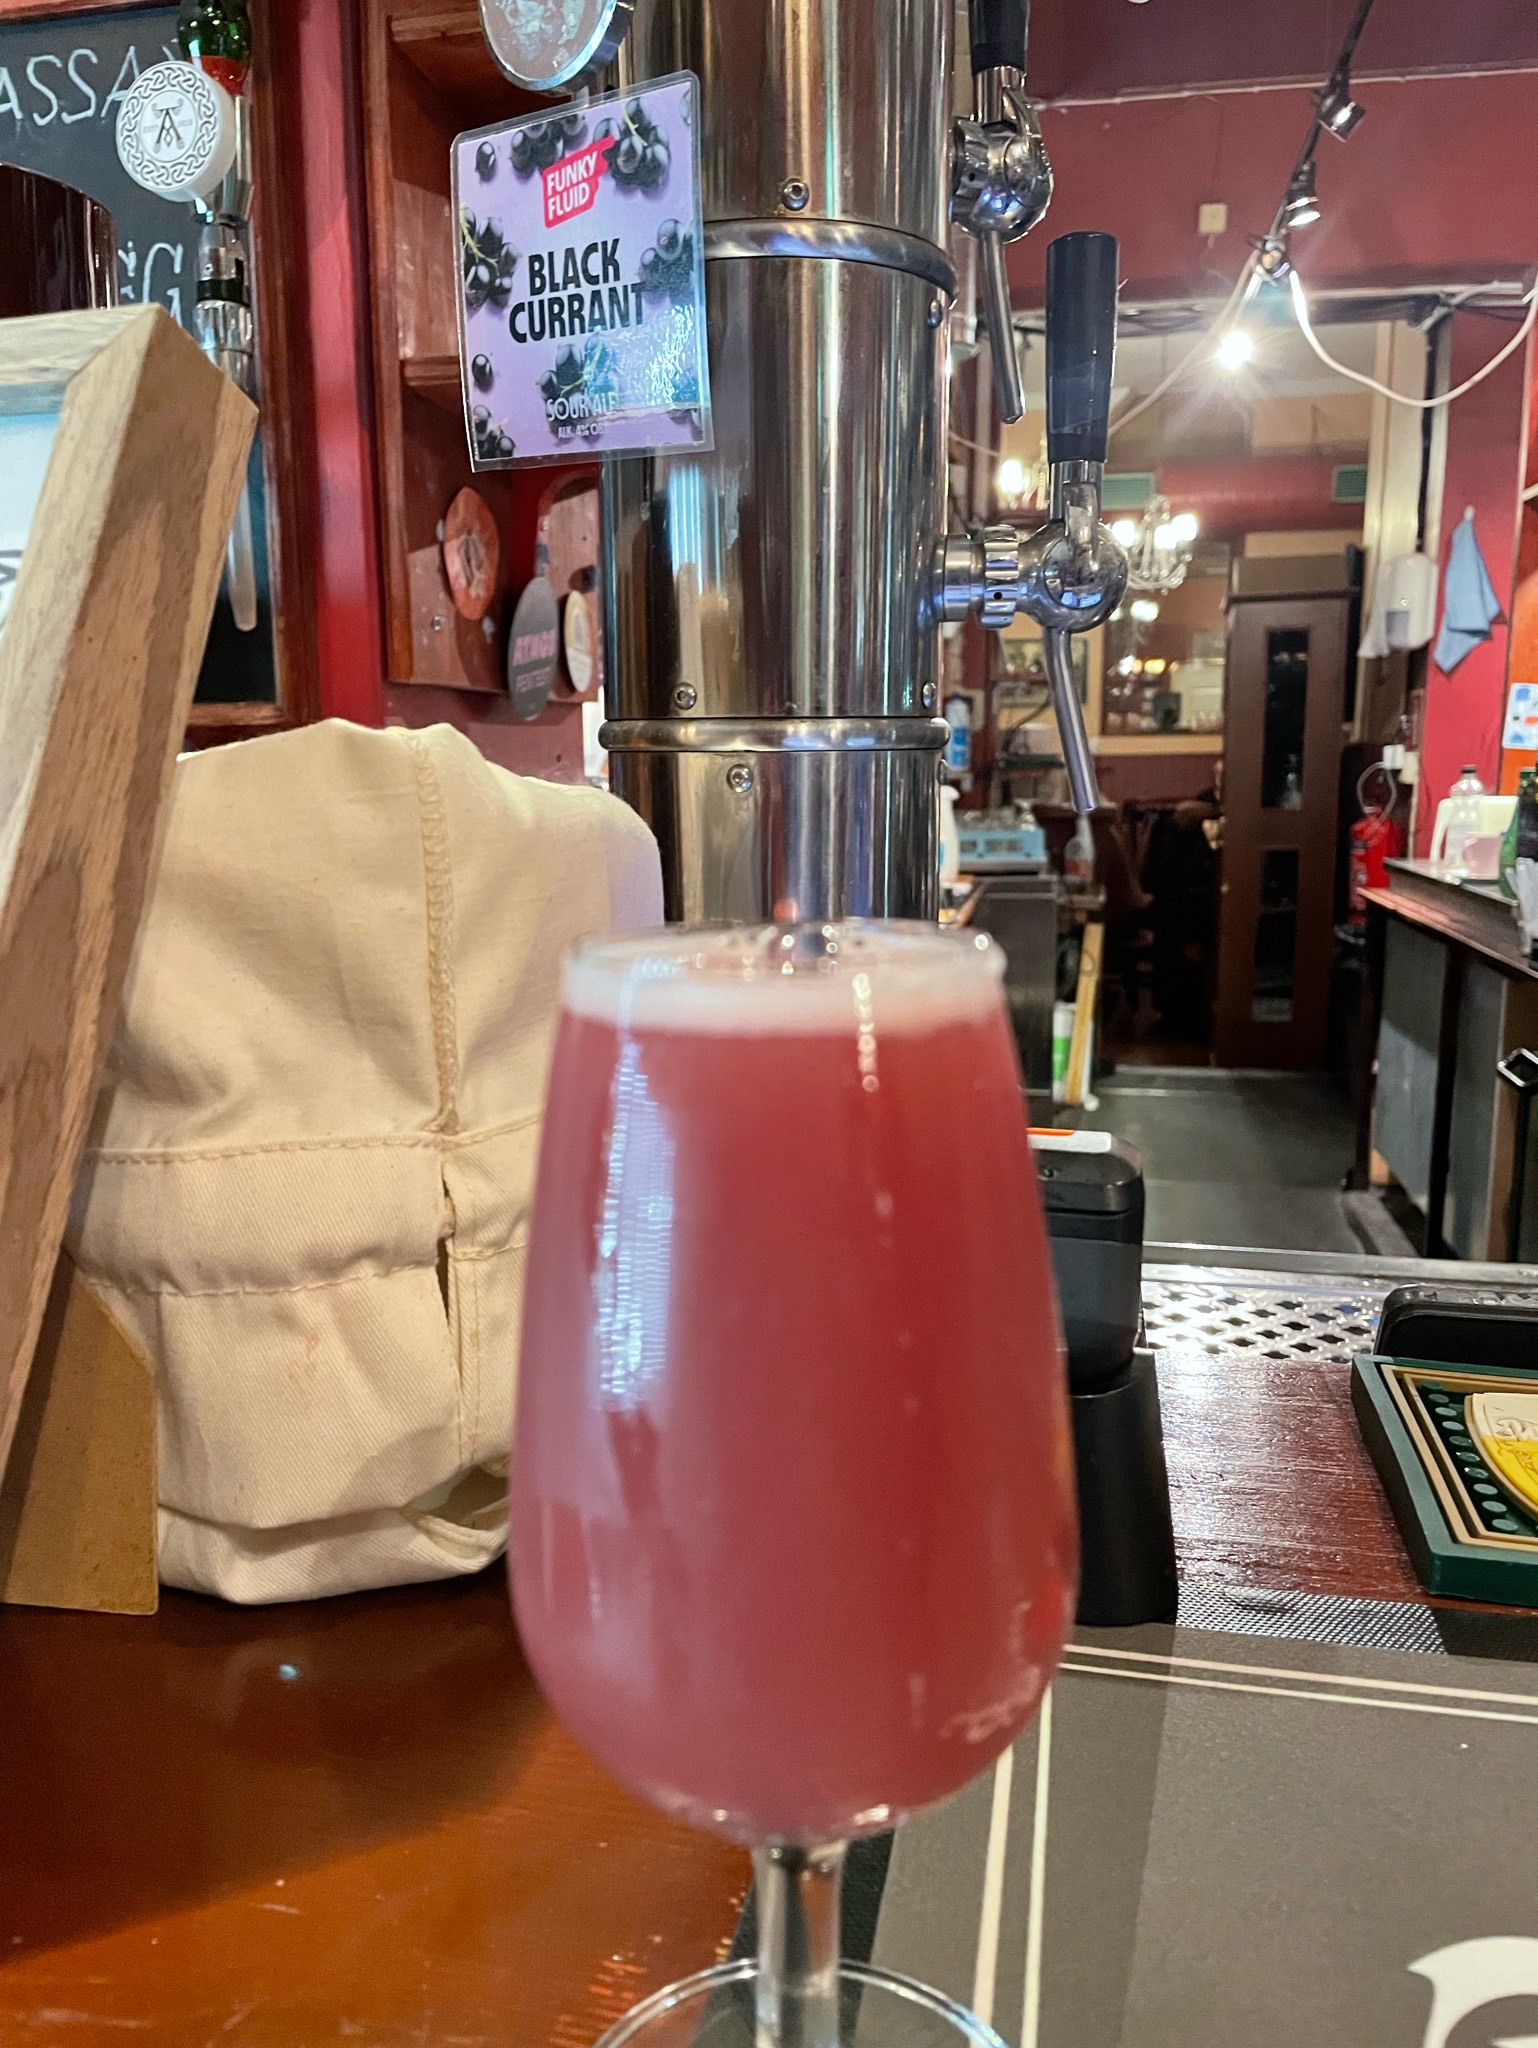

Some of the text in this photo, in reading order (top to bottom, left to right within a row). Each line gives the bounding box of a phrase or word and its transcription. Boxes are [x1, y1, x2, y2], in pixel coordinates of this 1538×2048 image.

[546, 150, 598, 197] FUNKY
[547, 181, 590, 221] FLUID
[528, 237, 621, 297] BLACK
[508, 282, 645, 344] CURRANT
[546, 395, 591, 422] SOUR
